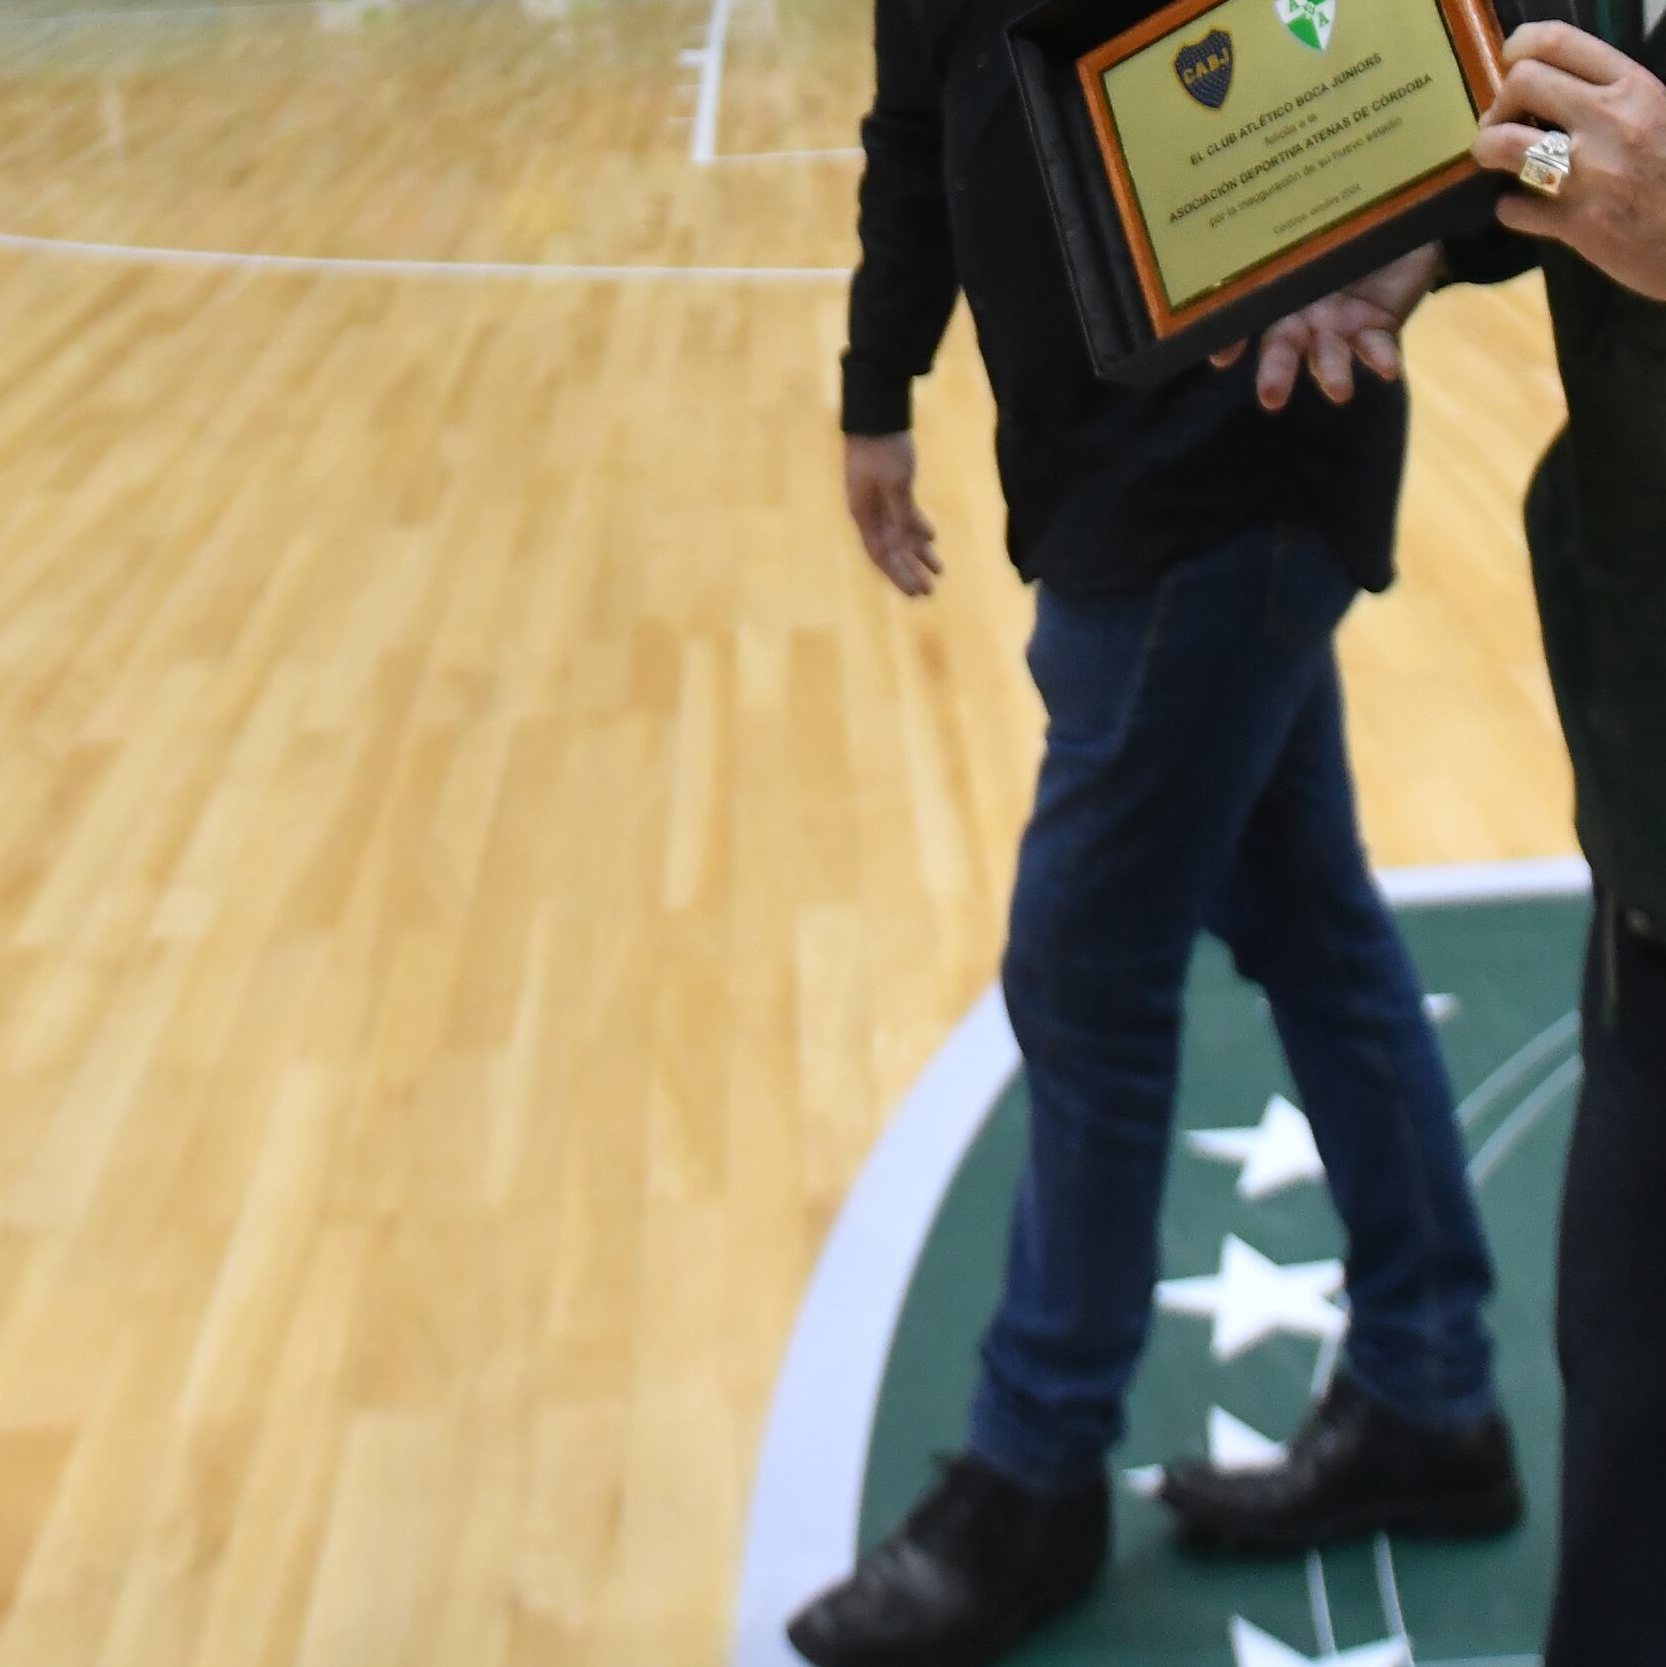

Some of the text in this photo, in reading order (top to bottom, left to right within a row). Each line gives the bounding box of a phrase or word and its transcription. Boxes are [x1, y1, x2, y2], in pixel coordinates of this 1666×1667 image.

[1183, 46, 1231, 86] CABJ
[1189, 52, 1383, 167] EL CLUB ATLÉTICO BOCA JUNIORS
[1169, 73, 1434, 225] ASOCIACIÓN DEPORTIVA ATENAS DE CÓRDOBA
